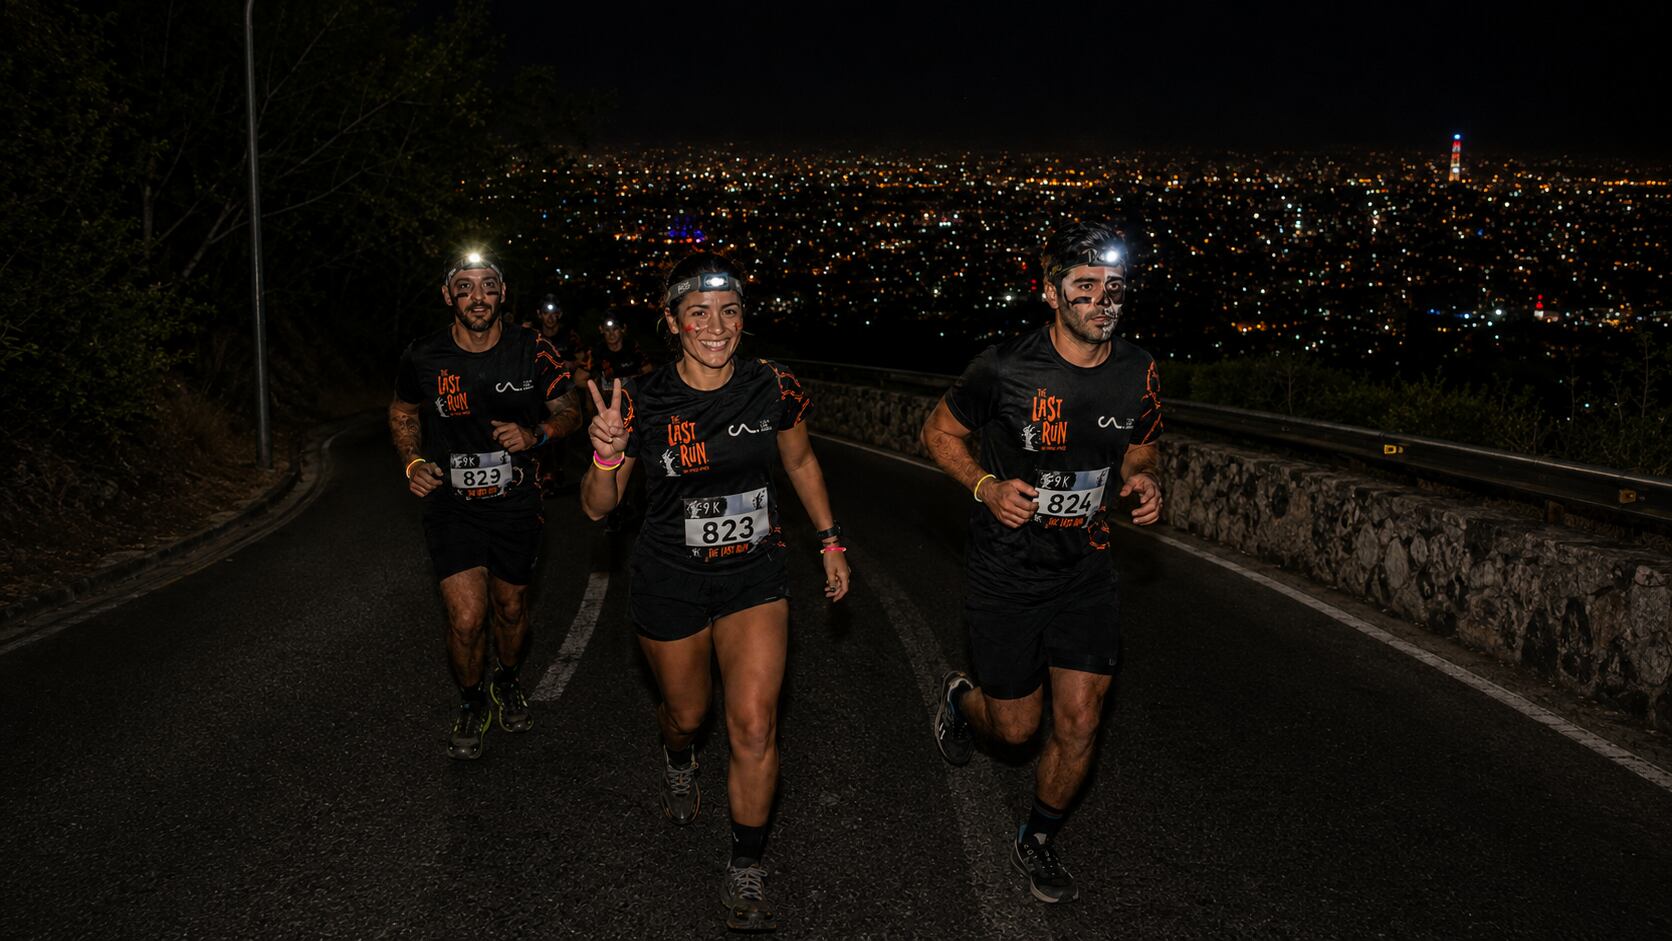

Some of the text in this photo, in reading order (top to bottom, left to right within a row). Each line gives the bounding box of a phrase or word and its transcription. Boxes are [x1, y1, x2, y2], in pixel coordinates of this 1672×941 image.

[438, 375, 460, 395] LAST
[447, 392, 468, 411] RUN
[1032, 395, 1062, 422] LAST
[668, 421, 696, 447] LAST
[1042, 422, 1067, 445] RUN
[680, 442, 707, 467] RUN
[463, 468, 501, 487] 829
[1047, 491, 1092, 515] 824
[702, 516, 755, 544] 823
[721, 545, 735, 557] LAST
